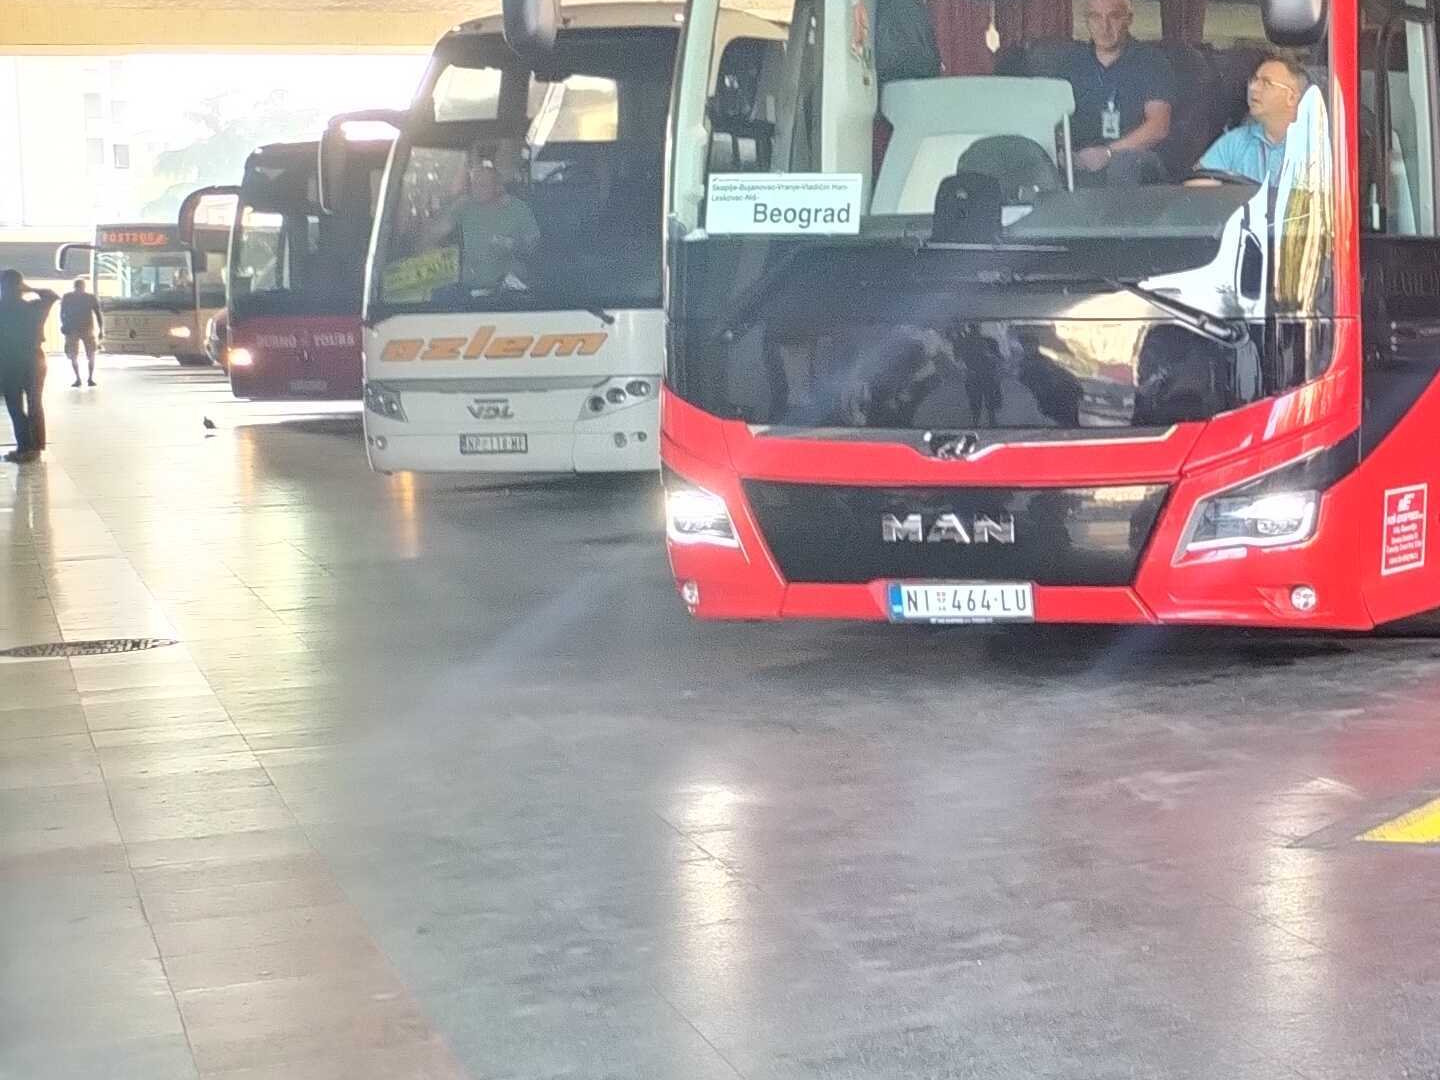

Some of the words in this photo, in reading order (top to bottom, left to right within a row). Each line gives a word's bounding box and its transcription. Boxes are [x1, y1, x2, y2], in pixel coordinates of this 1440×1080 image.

[753, 202, 851, 229] Beograd
[881, 512, 1015, 544] MAN
[906, 589, 930, 612] NI
